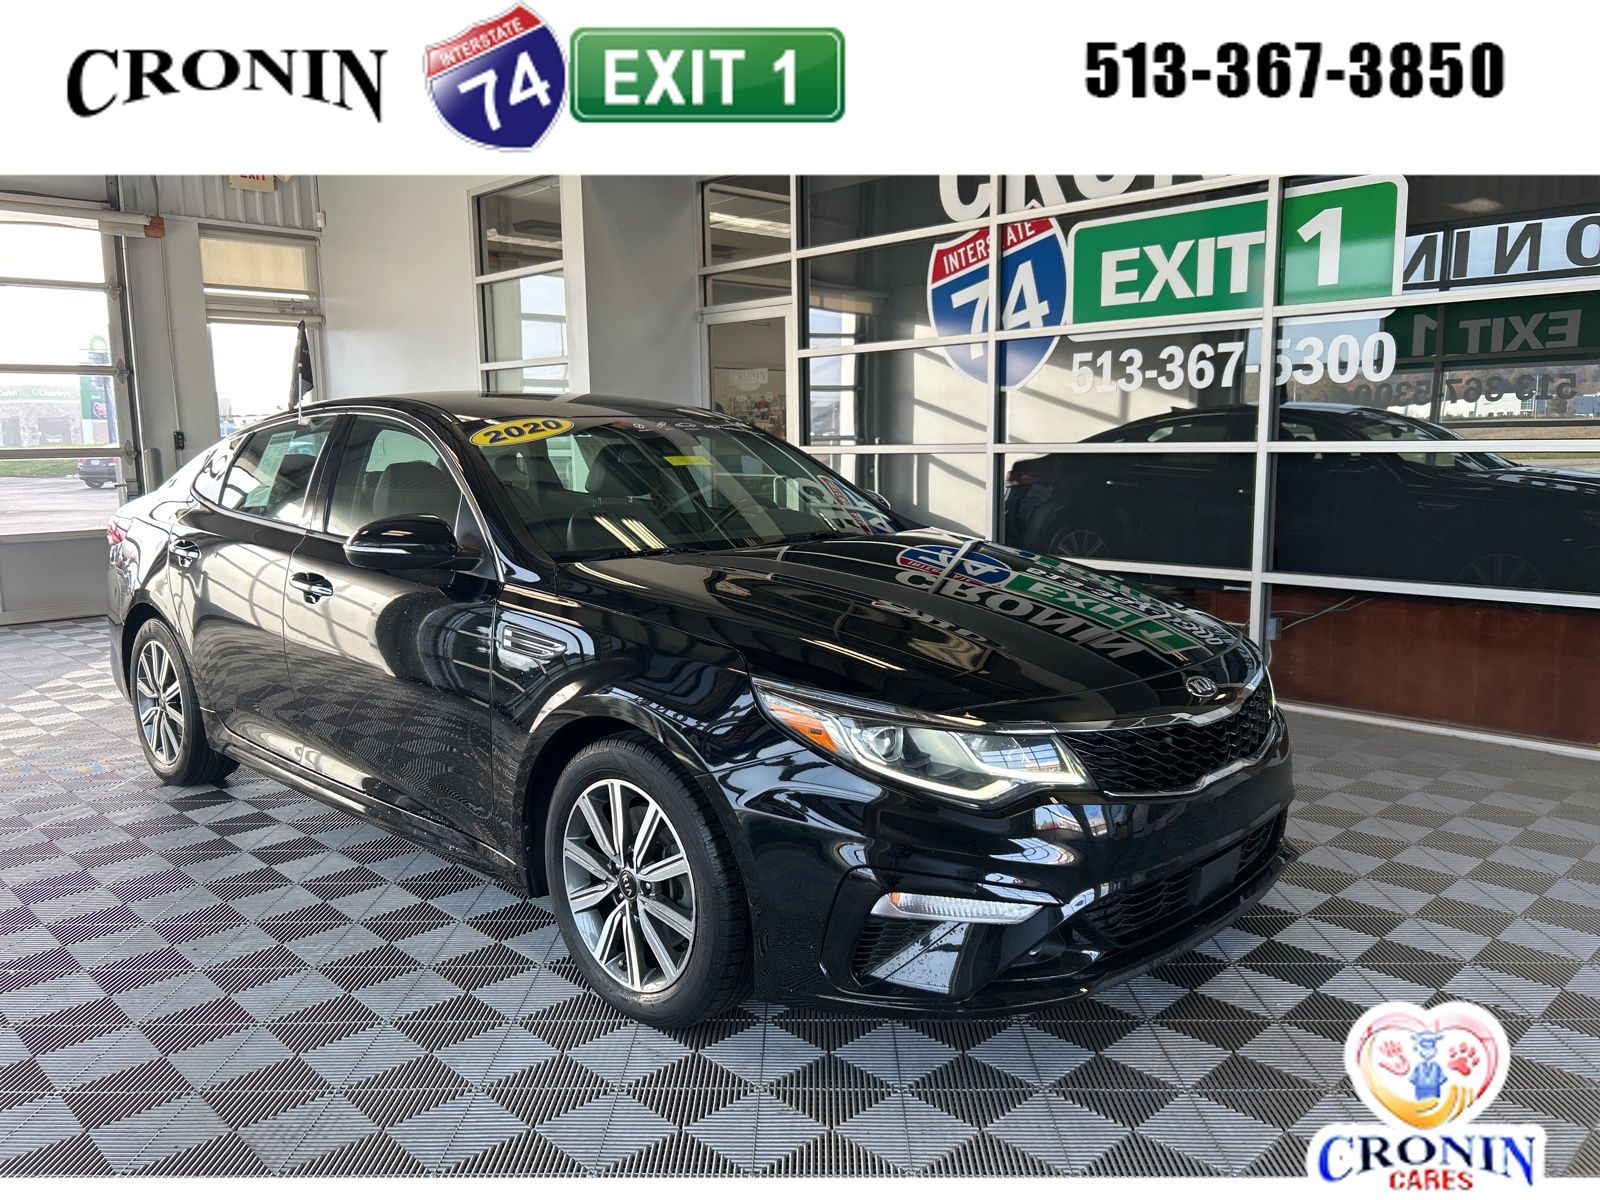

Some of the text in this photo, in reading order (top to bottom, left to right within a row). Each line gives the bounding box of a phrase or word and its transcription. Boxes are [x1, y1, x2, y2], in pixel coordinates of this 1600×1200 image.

[1100, 206, 1343, 307] EXIT 1
[951, 259, 1050, 361] 74
[1070, 331, 1397, 395] 513-367-5300
[483, 419, 563, 443] 2020
[622, 873, 632, 896] KIA
